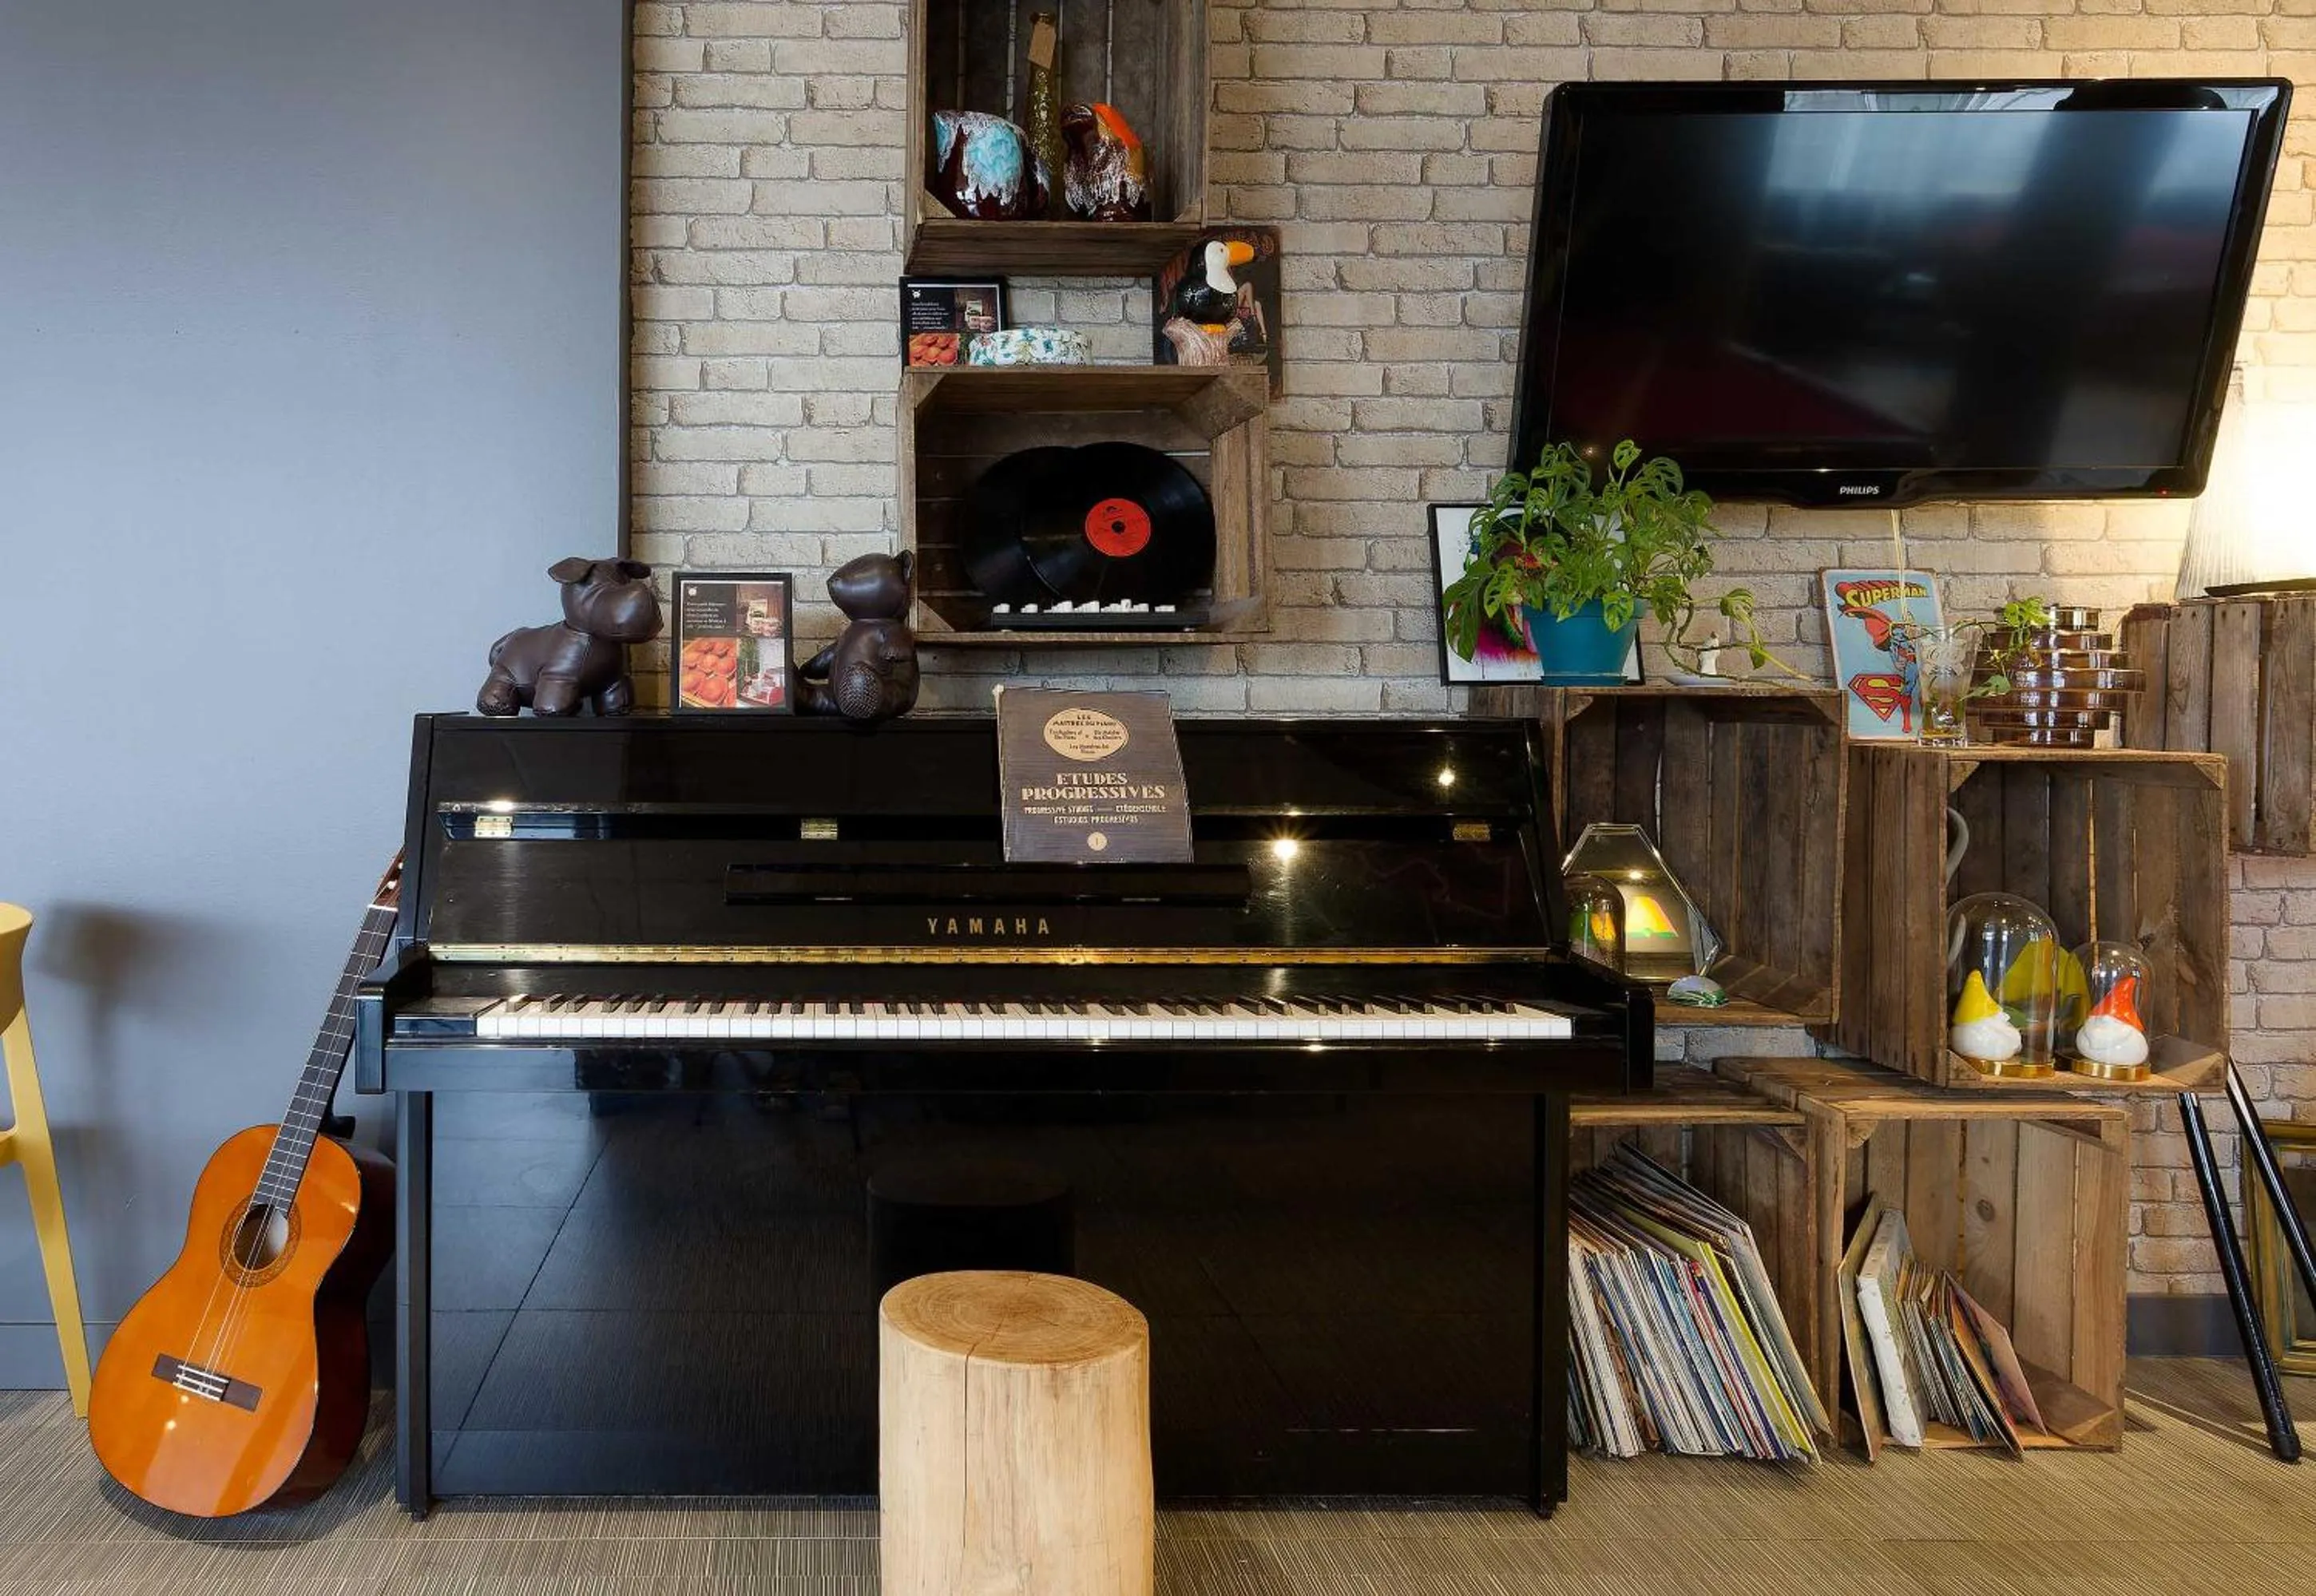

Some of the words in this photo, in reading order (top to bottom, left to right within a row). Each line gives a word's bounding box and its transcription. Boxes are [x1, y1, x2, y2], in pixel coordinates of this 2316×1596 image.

[1840, 485, 1880, 495] PHILIPS
[1844, 585, 1927, 608] SUPERMAN
[1057, 772, 1128, 786] ETUDES
[1021, 785, 1165, 801] PROGRESSIVES
[927, 917, 1050, 935] YAMAHA
